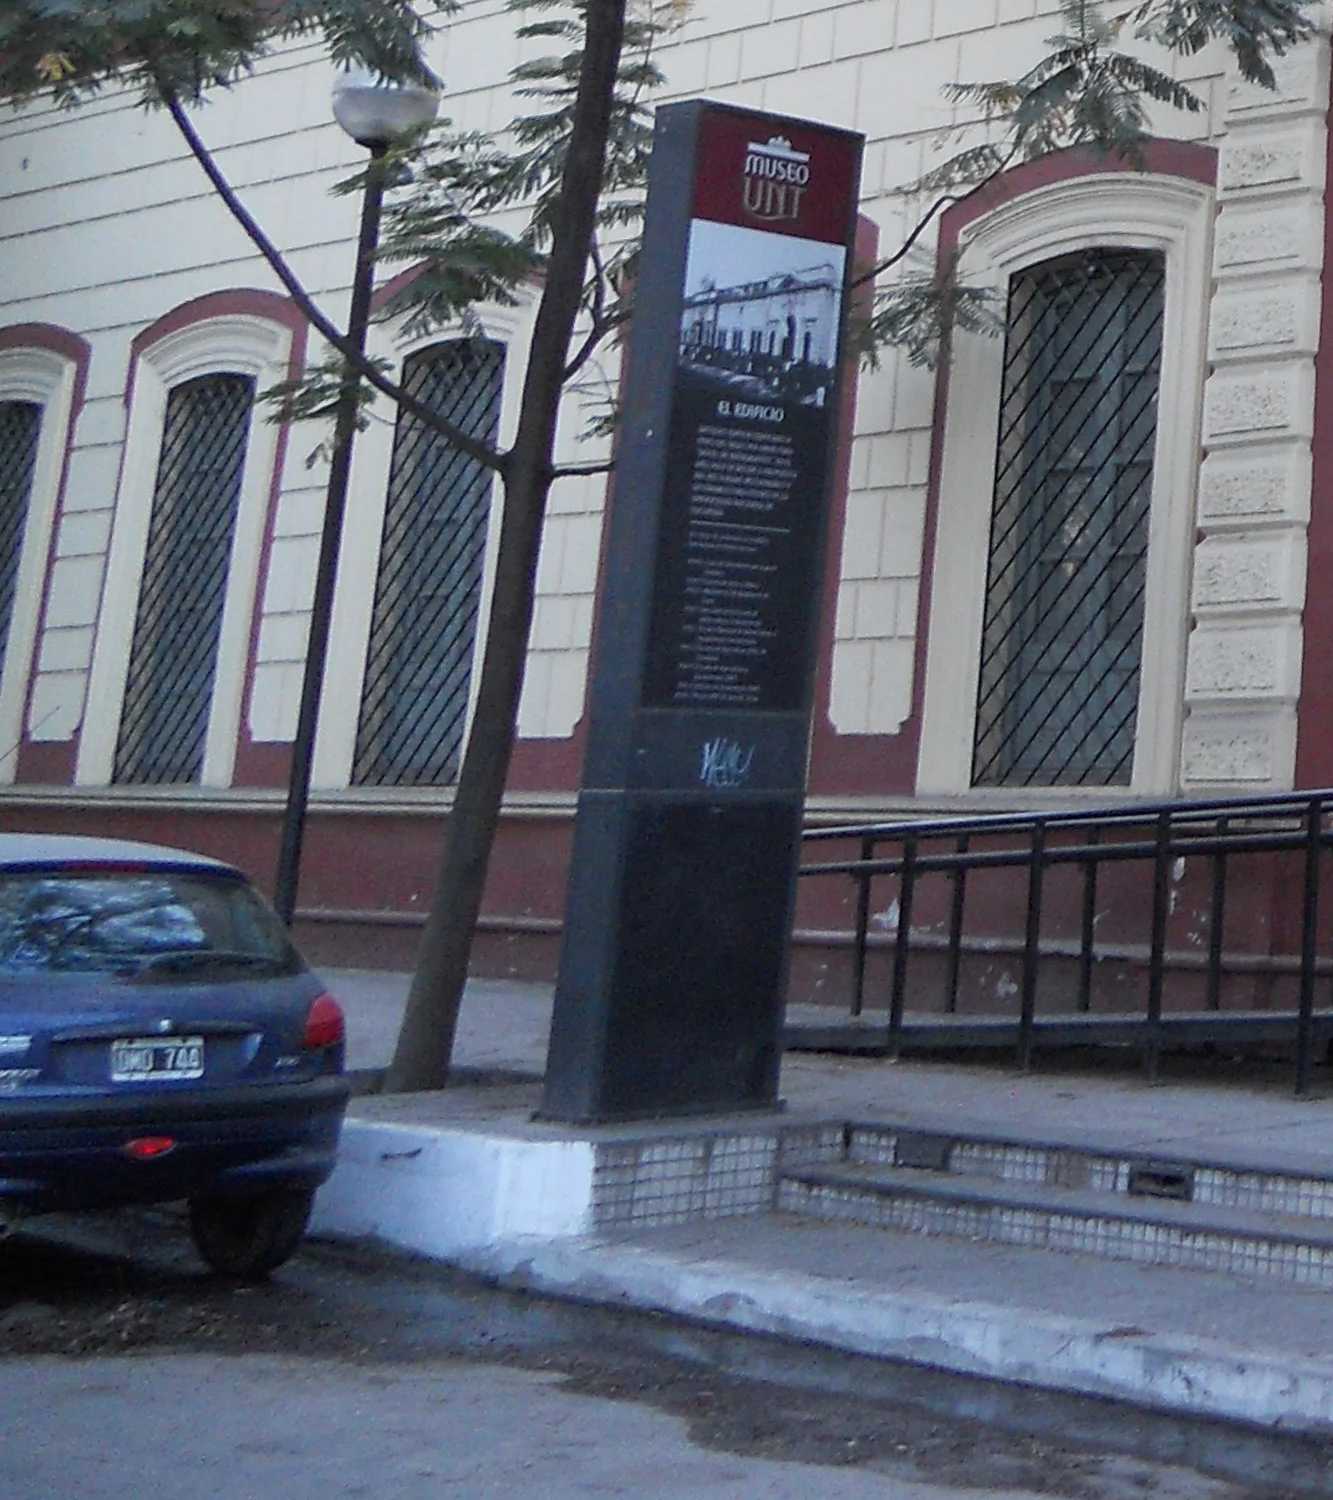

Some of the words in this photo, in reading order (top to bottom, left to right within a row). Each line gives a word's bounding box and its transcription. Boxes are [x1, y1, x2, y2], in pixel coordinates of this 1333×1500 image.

[744, 154, 810, 185] MUSEO
[743, 176, 808, 220] UNT
[717, 399, 732, 416] EL
[733, 402, 785, 423] EDIFICIO
